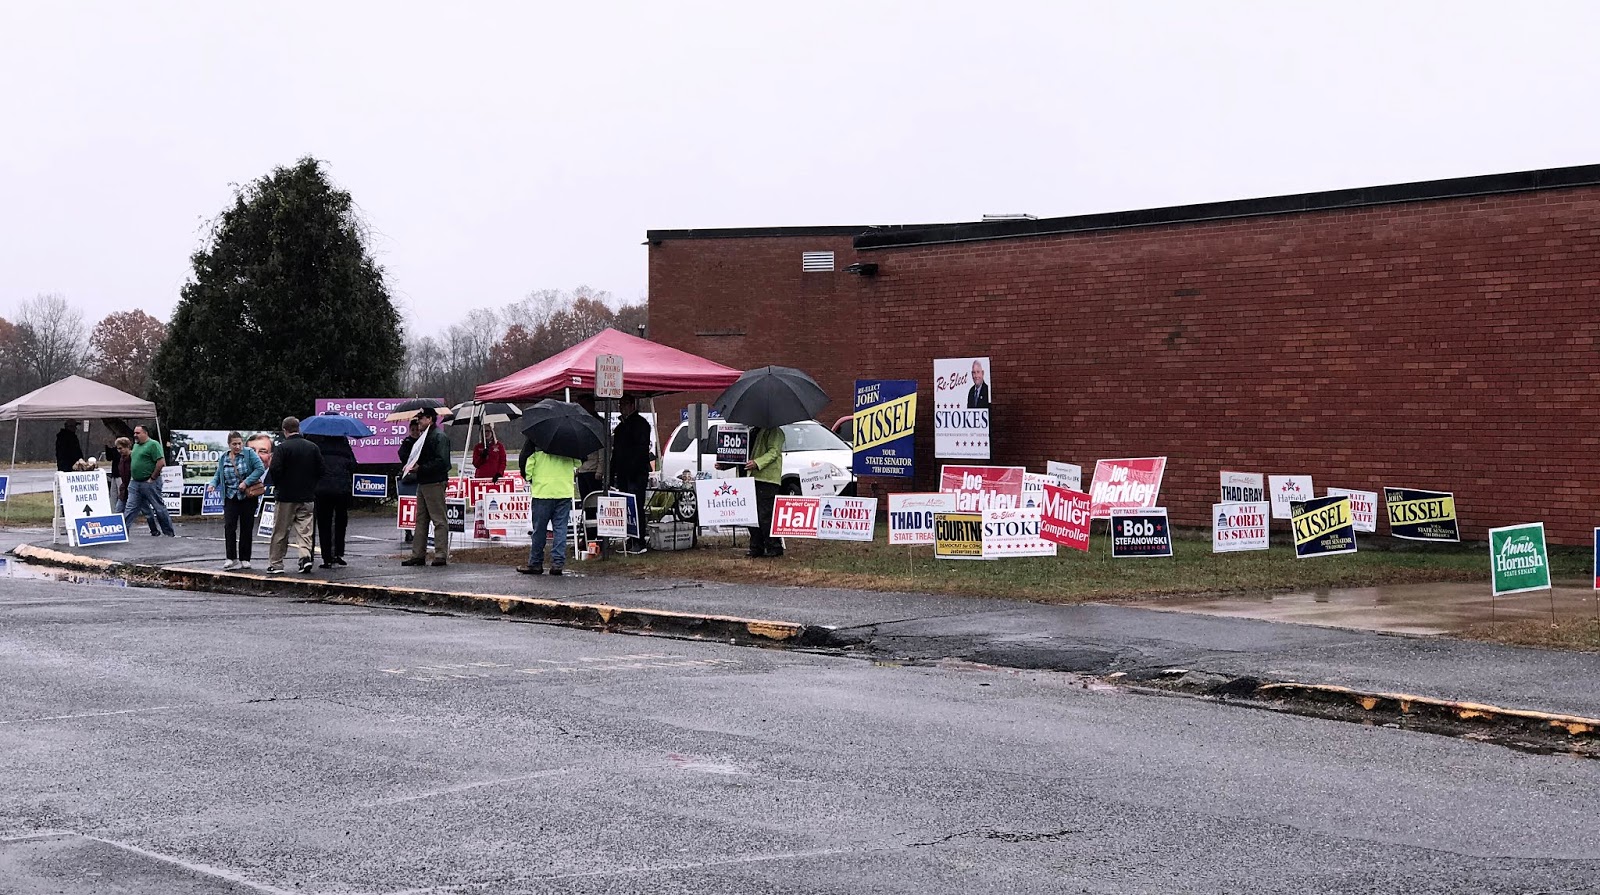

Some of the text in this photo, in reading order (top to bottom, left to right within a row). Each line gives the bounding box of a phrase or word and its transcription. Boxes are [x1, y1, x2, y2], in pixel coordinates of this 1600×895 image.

[936, 372, 968, 392] Re-Elect
[858, 384, 880, 394] RE-ELECT
[327, 402, 400, 410] Re-elect Car
[856, 391, 880, 408] JOHN
[855, 400, 913, 448] KISSEL
[936, 410, 988, 428] STOKES
[392, 426, 407, 434] 5D
[188, 442, 208, 451] Tom
[360, 439, 380, 447] your
[384, 437, 403, 445] ball
[724, 434, 741, 447] Bob
[175, 447, 224, 462] Arno
[865, 456, 912, 466] STATE SENATOR
[66, 474, 99, 483] HANDICAP
[1110, 465, 1128, 482] Joe
[70, 483, 99, 492] PARKING
[355, 481, 385, 490] Arnone
[961, 472, 982, 490] Joe
[76, 494, 97, 502] AHEAD
[1092, 481, 1155, 507] Markley
[1222, 486, 1263, 502] THAD GRAY
[1277, 494, 1306, 502] Hatfield
[500, 502, 530, 511] CORE
[707, 498, 746, 508] Hatfield
[1042, 489, 1090, 526] Miller
[1072, 497, 1090, 510] Kurt
[1349, 501, 1373, 512] OREY
[447, 506, 459, 518] ob
[604, 507, 624, 517] COREY
[777, 507, 819, 528] Hall
[833, 508, 872, 519] COREY
[1389, 500, 1450, 522] KISSEL
[890, 512, 921, 530] THAD
[1228, 514, 1265, 527] COREY
[1294, 504, 1347, 541] KISSEL
[1352, 514, 1372, 522] NATE
[80, 524, 123, 536] Arnone
[821, 520, 870, 530] US SENATE
[936, 521, 982, 541] COURTNE
[984, 521, 1040, 537] STOK
[1040, 520, 1088, 541] Comptroller
[1123, 519, 1154, 536] Bob
[1115, 537, 1167, 545] STEFANOWSKI
[1218, 529, 1265, 540] US SENATE
[1501, 536, 1534, 556] Annie
[1496, 548, 1544, 572] Hornish
